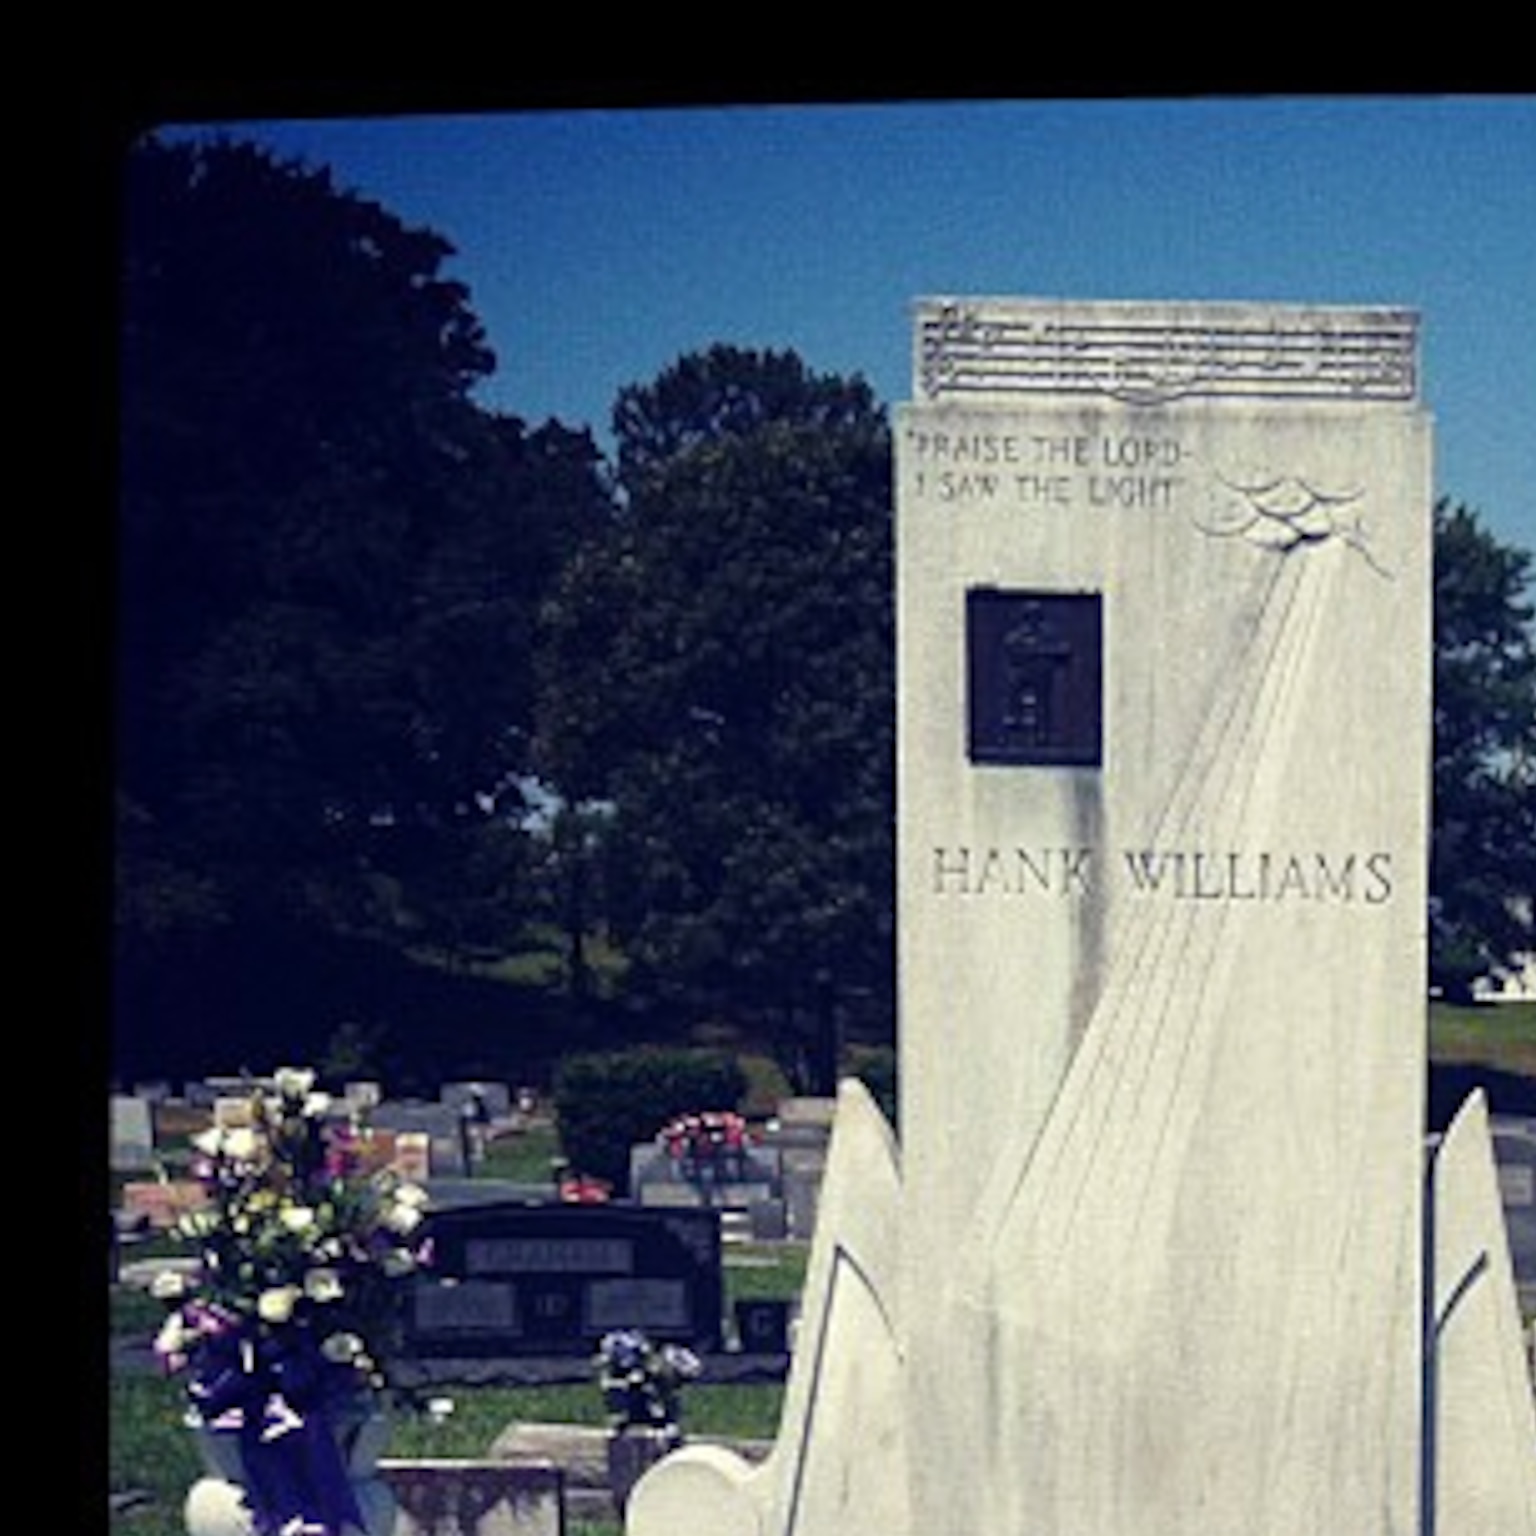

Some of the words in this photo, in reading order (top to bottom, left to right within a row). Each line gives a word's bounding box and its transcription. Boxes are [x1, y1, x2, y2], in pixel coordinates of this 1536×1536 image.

[1032, 434, 1090, 467] THE
[913, 471, 924, 498] I
[938, 472, 998, 502] SAW
[1015, 474, 1072, 503] THE
[933, 848, 1094, 896] HANK
[1123, 850, 1394, 904] WILLIAMS
